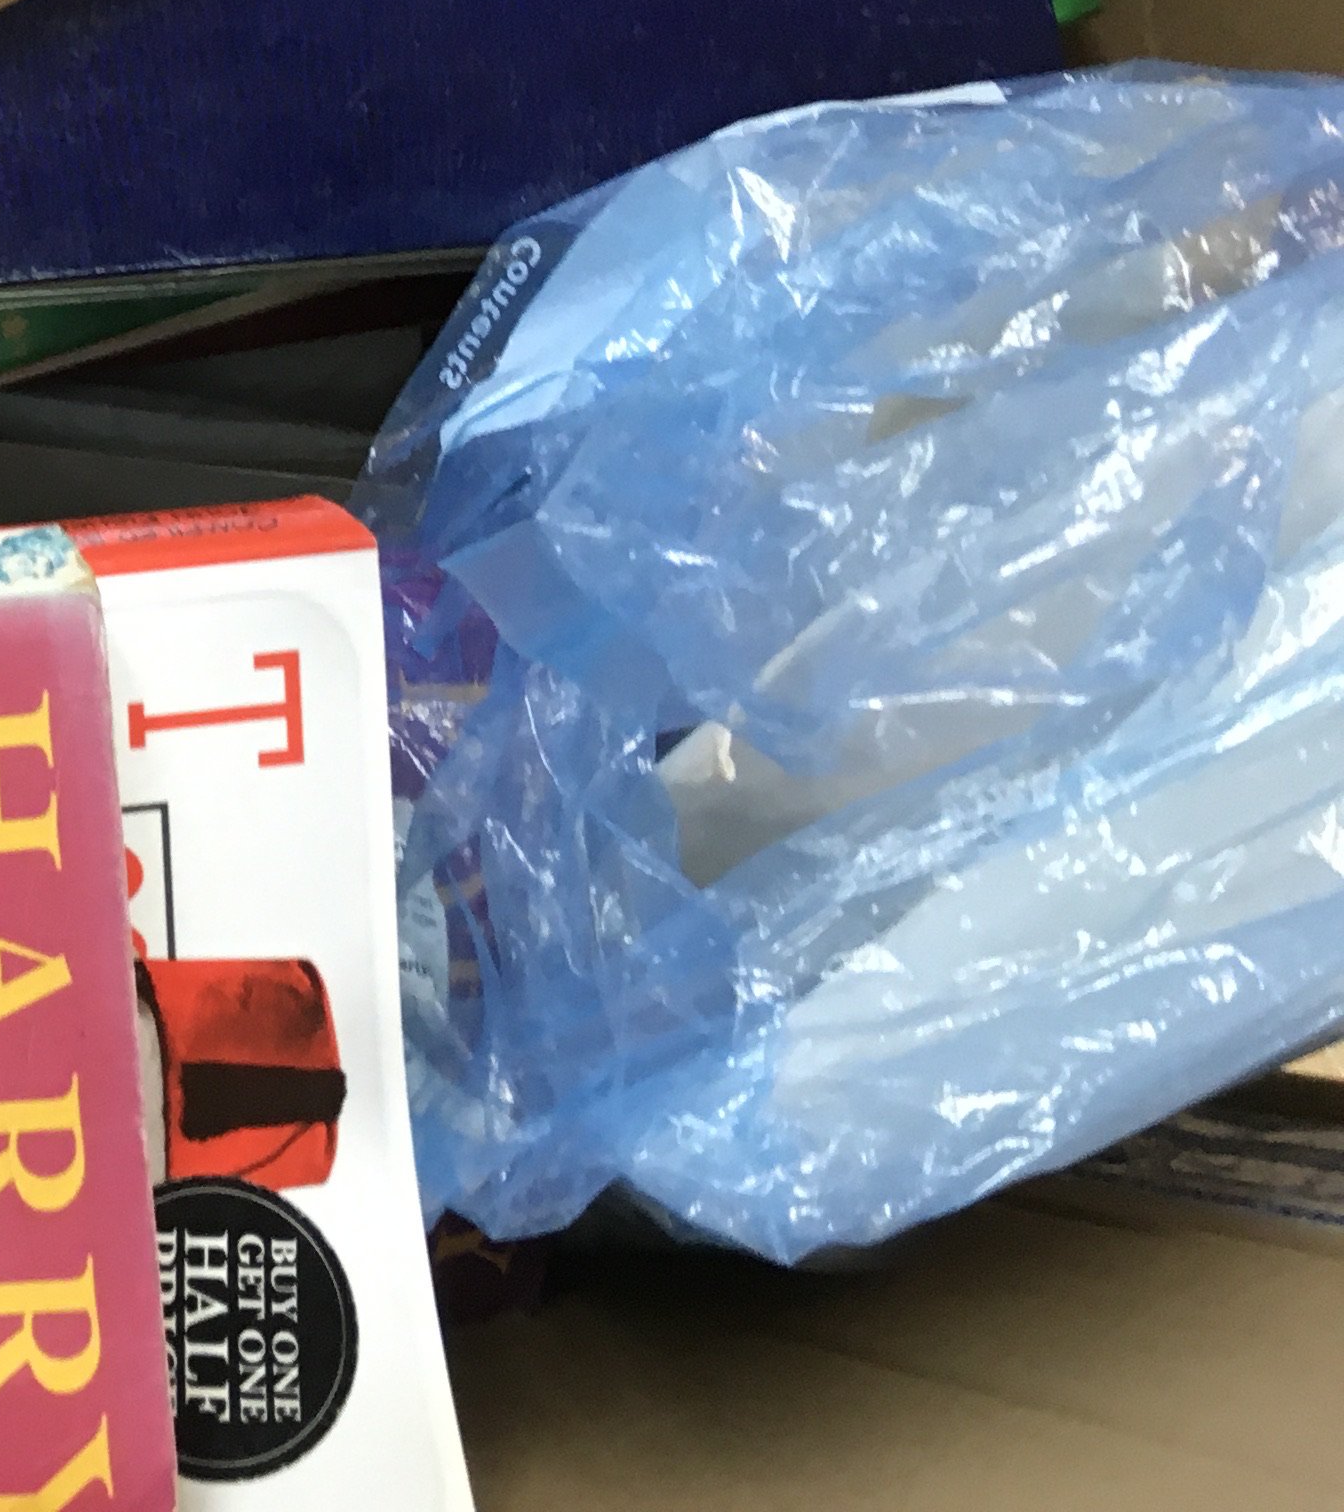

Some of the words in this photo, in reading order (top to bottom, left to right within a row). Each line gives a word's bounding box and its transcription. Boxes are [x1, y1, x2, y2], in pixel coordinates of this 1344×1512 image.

[237, 1234, 265, 1321] GET
[272, 1238, 299, 1323] BUY
[184, 1229, 231, 1424] HALF
[238, 1328, 268, 1424] ONE
[272, 1328, 301, 1423] ONE
